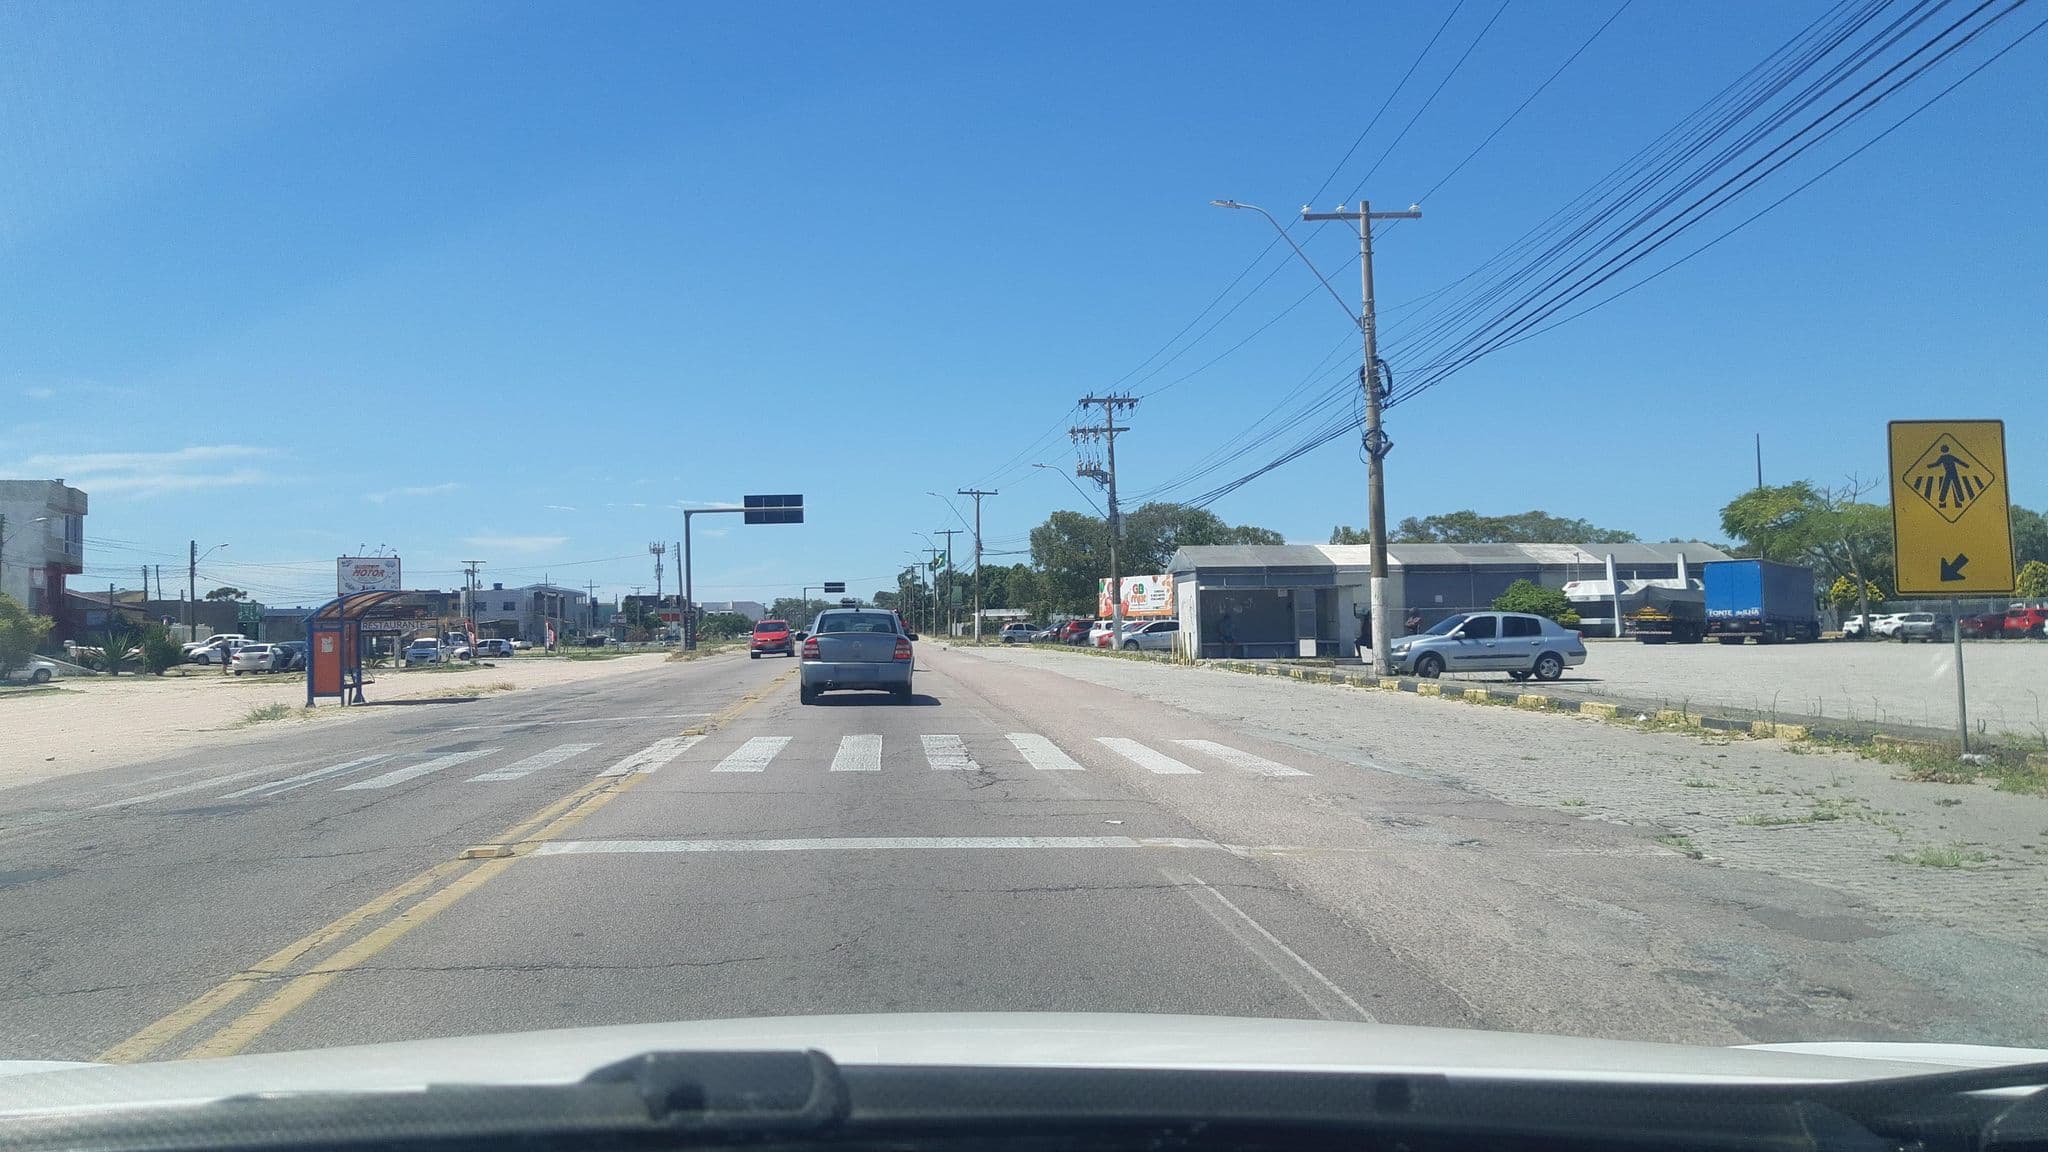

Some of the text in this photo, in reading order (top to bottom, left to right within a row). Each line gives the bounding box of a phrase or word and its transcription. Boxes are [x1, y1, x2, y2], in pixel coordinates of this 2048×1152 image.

[352, 569, 385, 577] MOTOR
[1132, 583, 1145, 595] GB
[362, 620, 426, 630] RESTAURANTE
